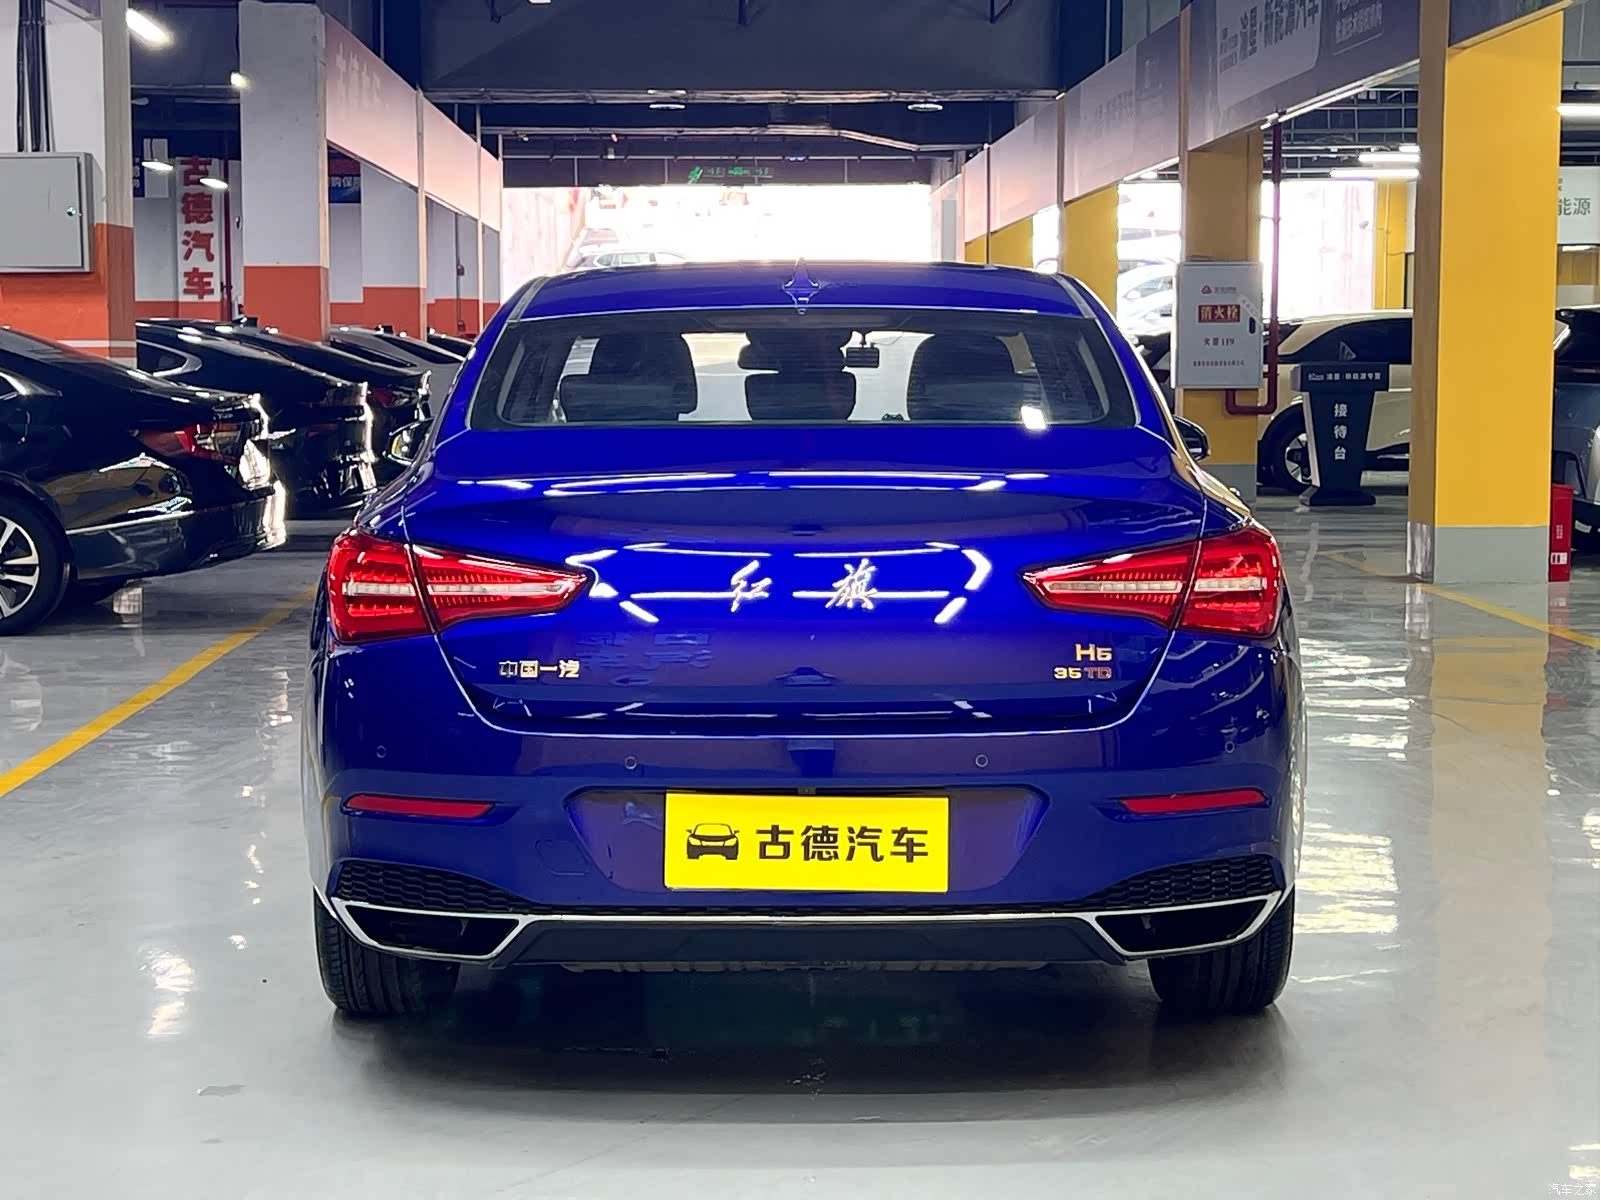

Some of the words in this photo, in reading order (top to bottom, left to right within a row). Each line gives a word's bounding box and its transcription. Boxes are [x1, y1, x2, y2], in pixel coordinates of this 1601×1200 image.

[180, 156, 215, 300] 古德汽车
[1200, 306, 1239, 321] 消火栓
[1334, 403, 1348, 461] 接待台
[730, 558, 878, 613] 红旗
[498, 659, 580, 679] 中国一汽
[1075, 643, 1113, 661] H6
[755, 824, 929, 864] 古德汽车
